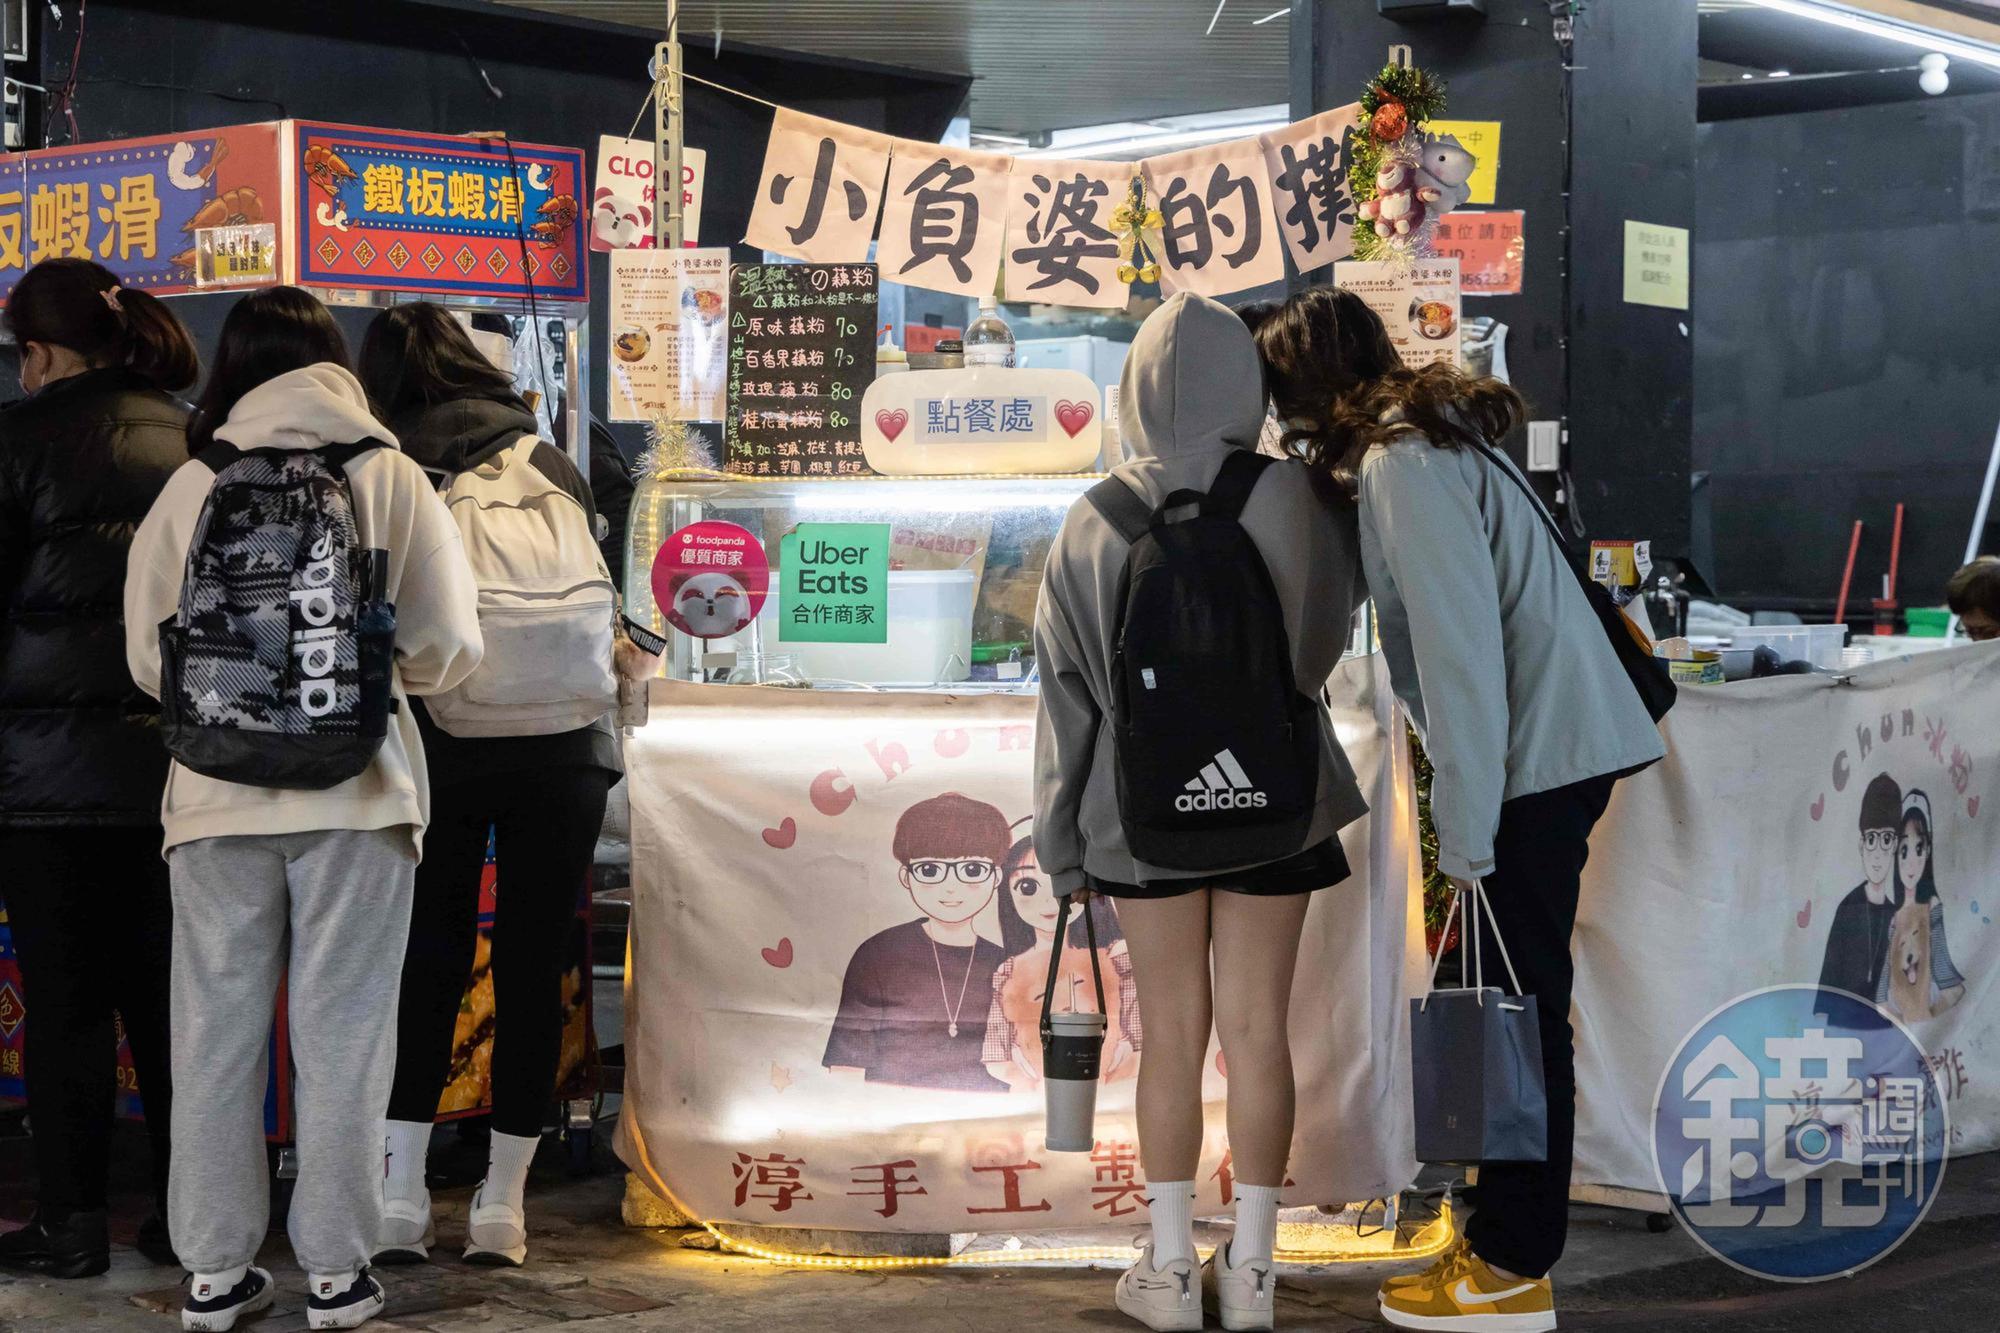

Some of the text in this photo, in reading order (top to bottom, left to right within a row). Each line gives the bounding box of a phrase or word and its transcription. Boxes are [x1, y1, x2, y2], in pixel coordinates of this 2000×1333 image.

[608, 156, 695, 185] CLOD
[362, 163, 525, 224] 鐵板蝦滑
[642, 185, 692, 208] 休中
[746, 316, 858, 338] 原味藕粉 70
[745, 348, 824, 369] 百香果藕粉
[742, 380, 852, 400] 玫瑰藕粉 80
[830, 411, 849, 428] 80
[927, 398, 1033, 434] 點餐處
[696, 536, 746, 547] foodpanda
[800, 540, 869, 565] Uber
[680, 548, 743, 566] 優質商家
[799, 569, 869, 595] Eats
[289, 527, 337, 718] adidas
[792, 603, 875, 625] 合作商家
[1175, 786, 1268, 812] adidas
[731, 1140, 1296, 1219] 淳手工製
